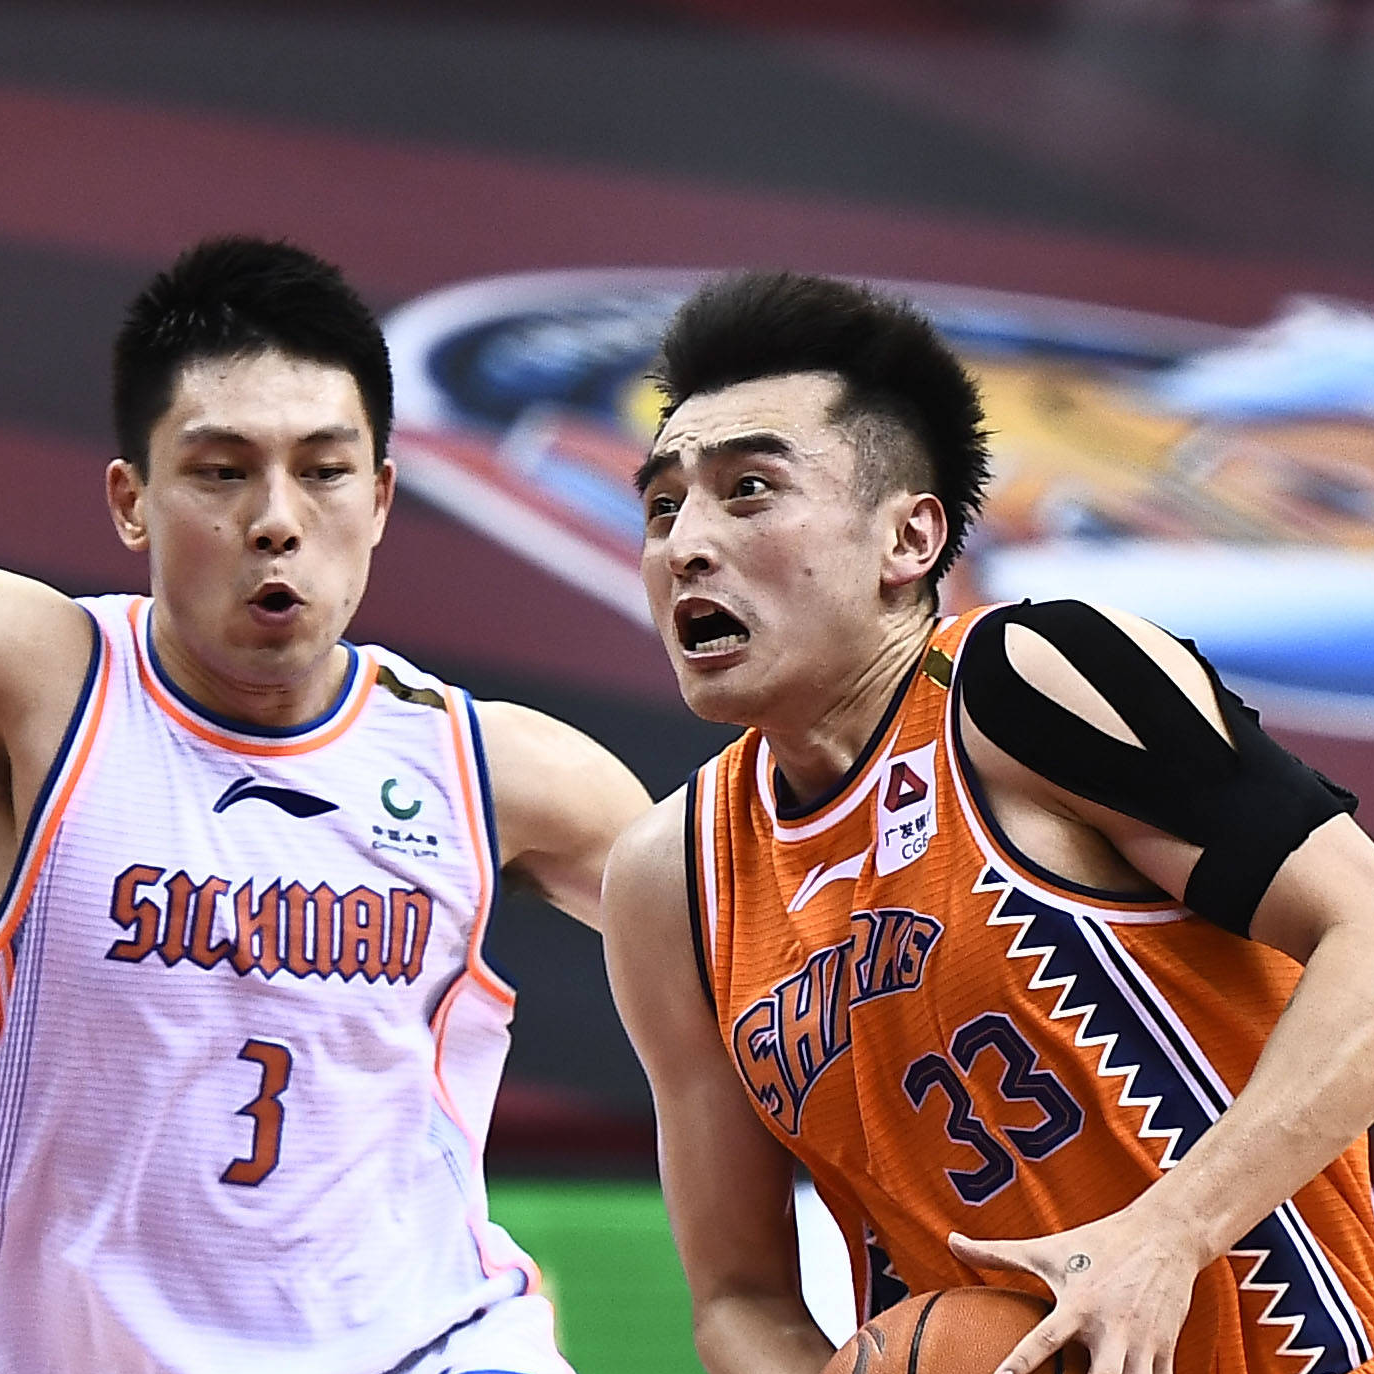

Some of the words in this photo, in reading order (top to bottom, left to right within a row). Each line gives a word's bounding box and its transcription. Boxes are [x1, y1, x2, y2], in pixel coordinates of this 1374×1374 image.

[884, 804, 932, 848] 广发银
[104, 863, 434, 986] SICHUAN
[218, 1038, 294, 1188] 3
[901, 1011, 1086, 1208] 33
